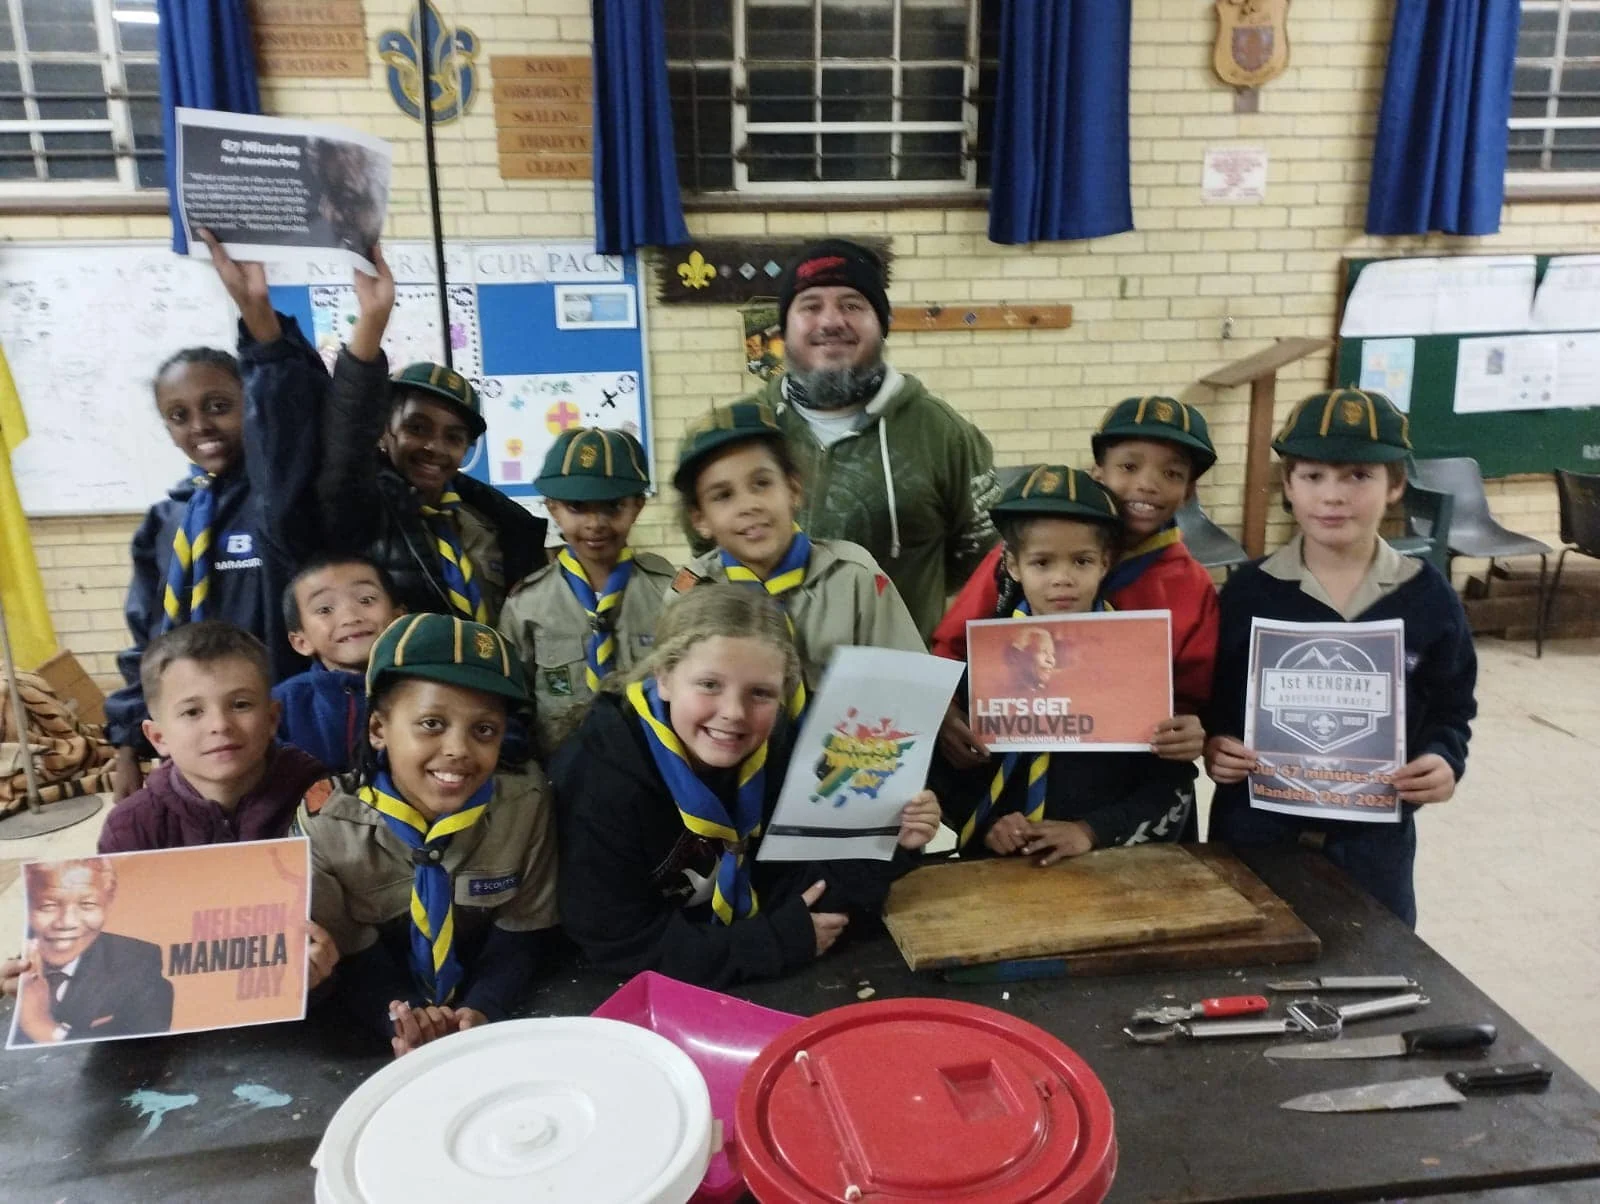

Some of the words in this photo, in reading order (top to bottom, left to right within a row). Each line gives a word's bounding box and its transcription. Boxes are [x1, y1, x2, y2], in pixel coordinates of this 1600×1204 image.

[477, 253, 539, 275] CUB
[546, 252, 620, 273] PACK
[226, 534, 253, 554] B
[1281, 676, 1301, 690] 1st
[1307, 676, 1371, 693] KENGRAY
[1032, 697, 1072, 716] GET
[976, 714, 1095, 736] INVOLVED
[1303, 768, 1369, 784] minutes
[1372, 773, 1392, 785] fo
[1254, 783, 1317, 802] Mandela
[1319, 789, 1350, 807] Day
[191, 902, 287, 941] NELSON
[168, 932, 288, 977] MANDELA
[236, 965, 285, 1001] DAY
